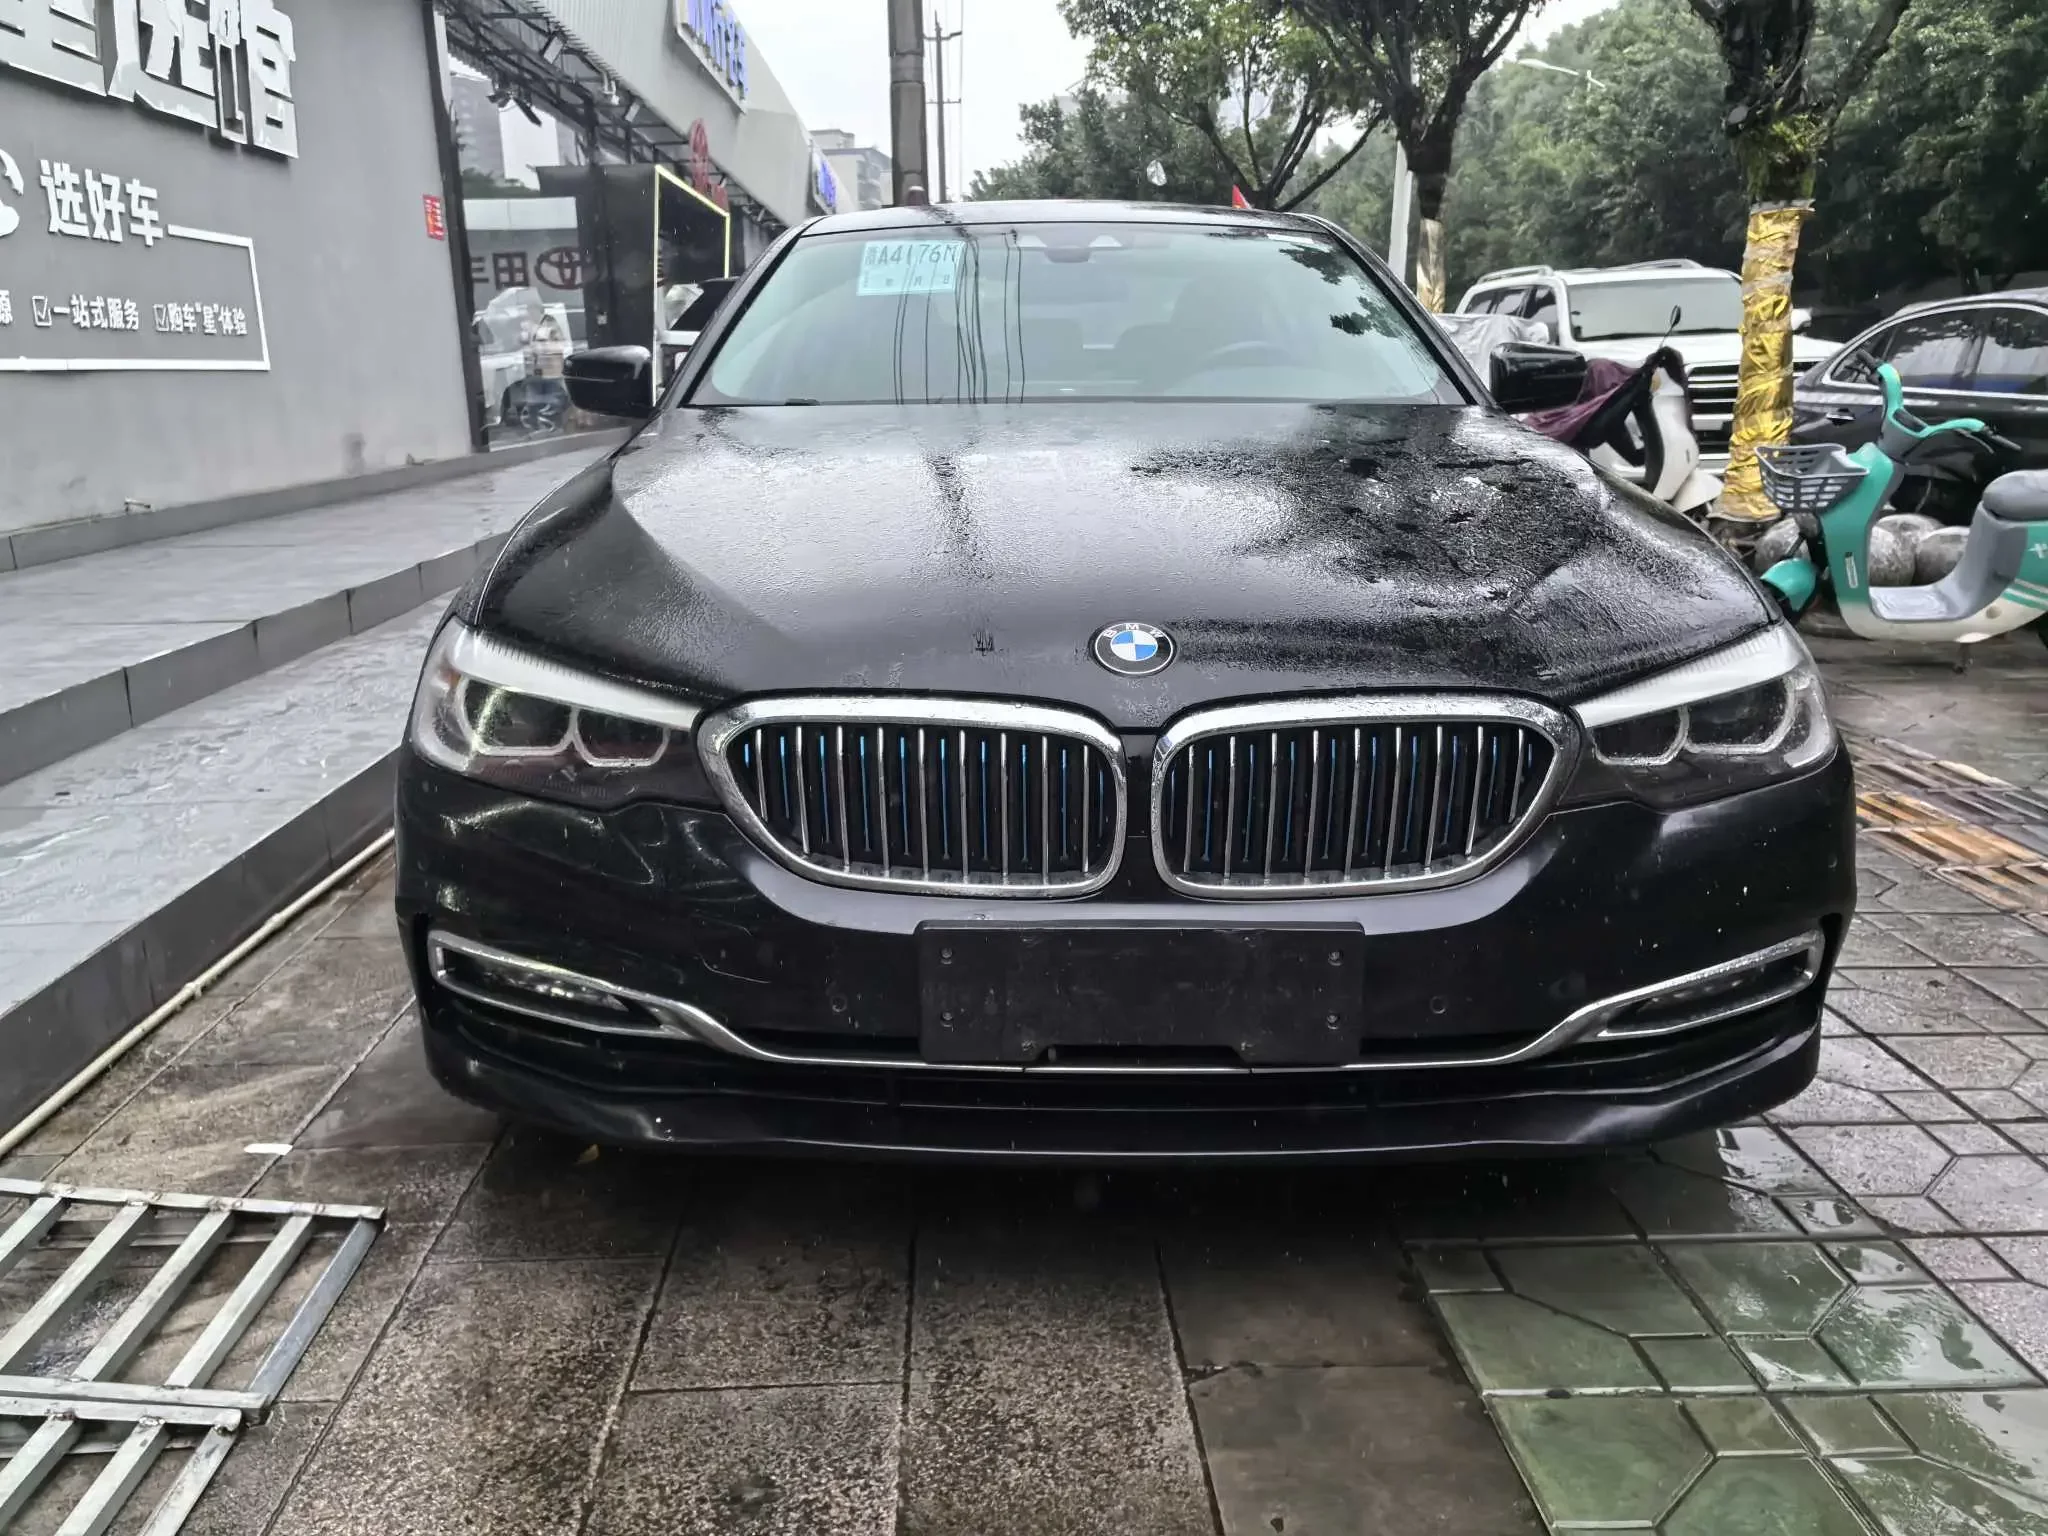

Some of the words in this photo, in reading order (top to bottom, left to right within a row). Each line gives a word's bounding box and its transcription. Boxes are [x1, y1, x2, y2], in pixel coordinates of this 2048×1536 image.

[39, 158, 164, 247] 选好车
[53, 293, 140, 331] 一站式服务
[1102, 623, 1164, 639] BMW
